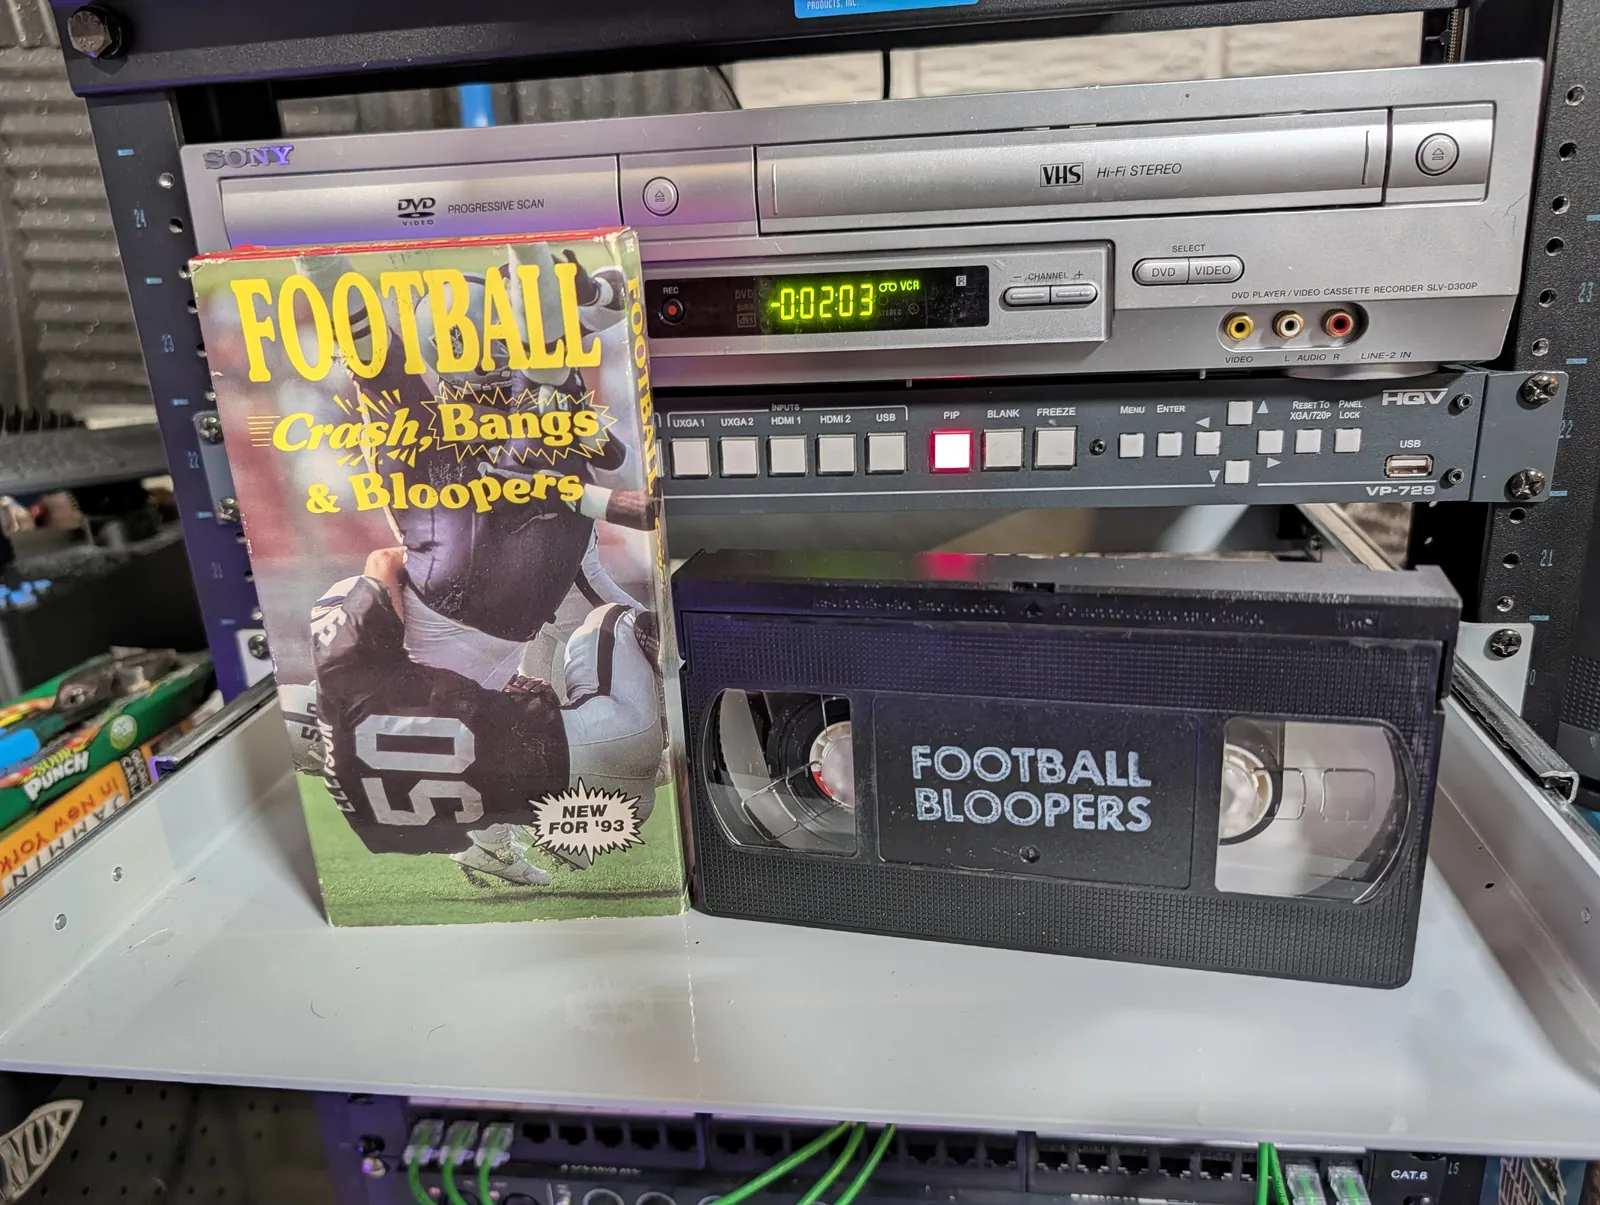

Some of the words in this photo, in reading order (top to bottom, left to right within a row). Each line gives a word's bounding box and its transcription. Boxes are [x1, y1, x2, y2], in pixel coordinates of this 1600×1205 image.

[204, 145, 293, 170] SONY
[1041, 164, 1082, 185] VHS
[1096, 165, 1127, 178] Hi-Fi
[1130, 162, 1182, 177] STEREO
[397, 197, 436, 212] DVD
[447, 200, 515, 214] PROGRESSIVE
[517, 198, 545, 210] SCAN
[402, 219, 434, 227] VIDEO
[1171, 243, 1206, 253] SELECT
[1027, 271, 1069, 281] CHANNEL
[1151, 267, 1176, 278] DVD
[1194, 265, 1232, 276] VIDEO
[662, 286, 680, 296] REC
[900, 280, 920, 291] VCR
[1231, 291, 1250, 300] DVD
[1323, 286, 1370, 296] CASSETTE
[1373, 284, 1424, 294] RECORDER
[1426, 282, 1478, 293] SLV-D300P
[230, 262, 602, 383] FOOTBALL
[1224, 355, 1254, 365] VIDEO
[1296, 353, 1327, 362] AUDIO
[1332, 353, 1340, 361] R
[1360, 351, 1396, 360] LINE-2
[1399, 350, 1412, 359] IN
[626, 275, 658, 495] FOOTBALL
[1381, 391, 1448, 406] HQV
[771, 403, 801, 412] INPUTS
[986, 408, 1020, 419] BLANK
[1036, 406, 1076, 417] FREEZE
[771, 416, 795, 426] HDMI
[820, 415, 844, 425] HDMI
[845, 414, 852, 423] 2
[876, 413, 896, 422] USB
[943, 410, 960, 420] PIP
[272, 406, 434, 452] Crash,
[437, 402, 599, 447] Bangs
[672, 419, 699, 428] UXGA
[720, 418, 747, 427] UXGA
[1399, 439, 1421, 449] USB
[306, 481, 341, 514] &
[347, 472, 585, 514] Bloopers
[1365, 485, 1436, 497] VP-729
[1539, 549, 1553, 567] 21
[355, 714, 485, 826] 50
[911, 745, 1153, 788] FOOTBALL
[23, 750, 90, 801] PUNCH
[53, 793, 97, 833] New
[561, 803, 608, 819] NEW
[914, 787, 1153, 833] BLOOPERS
[548, 820, 589, 835] FOR
[594, 819, 625, 833] '93
[0, 832, 50, 874] York
[1390, 1169, 1429, 1181] CAT.6
